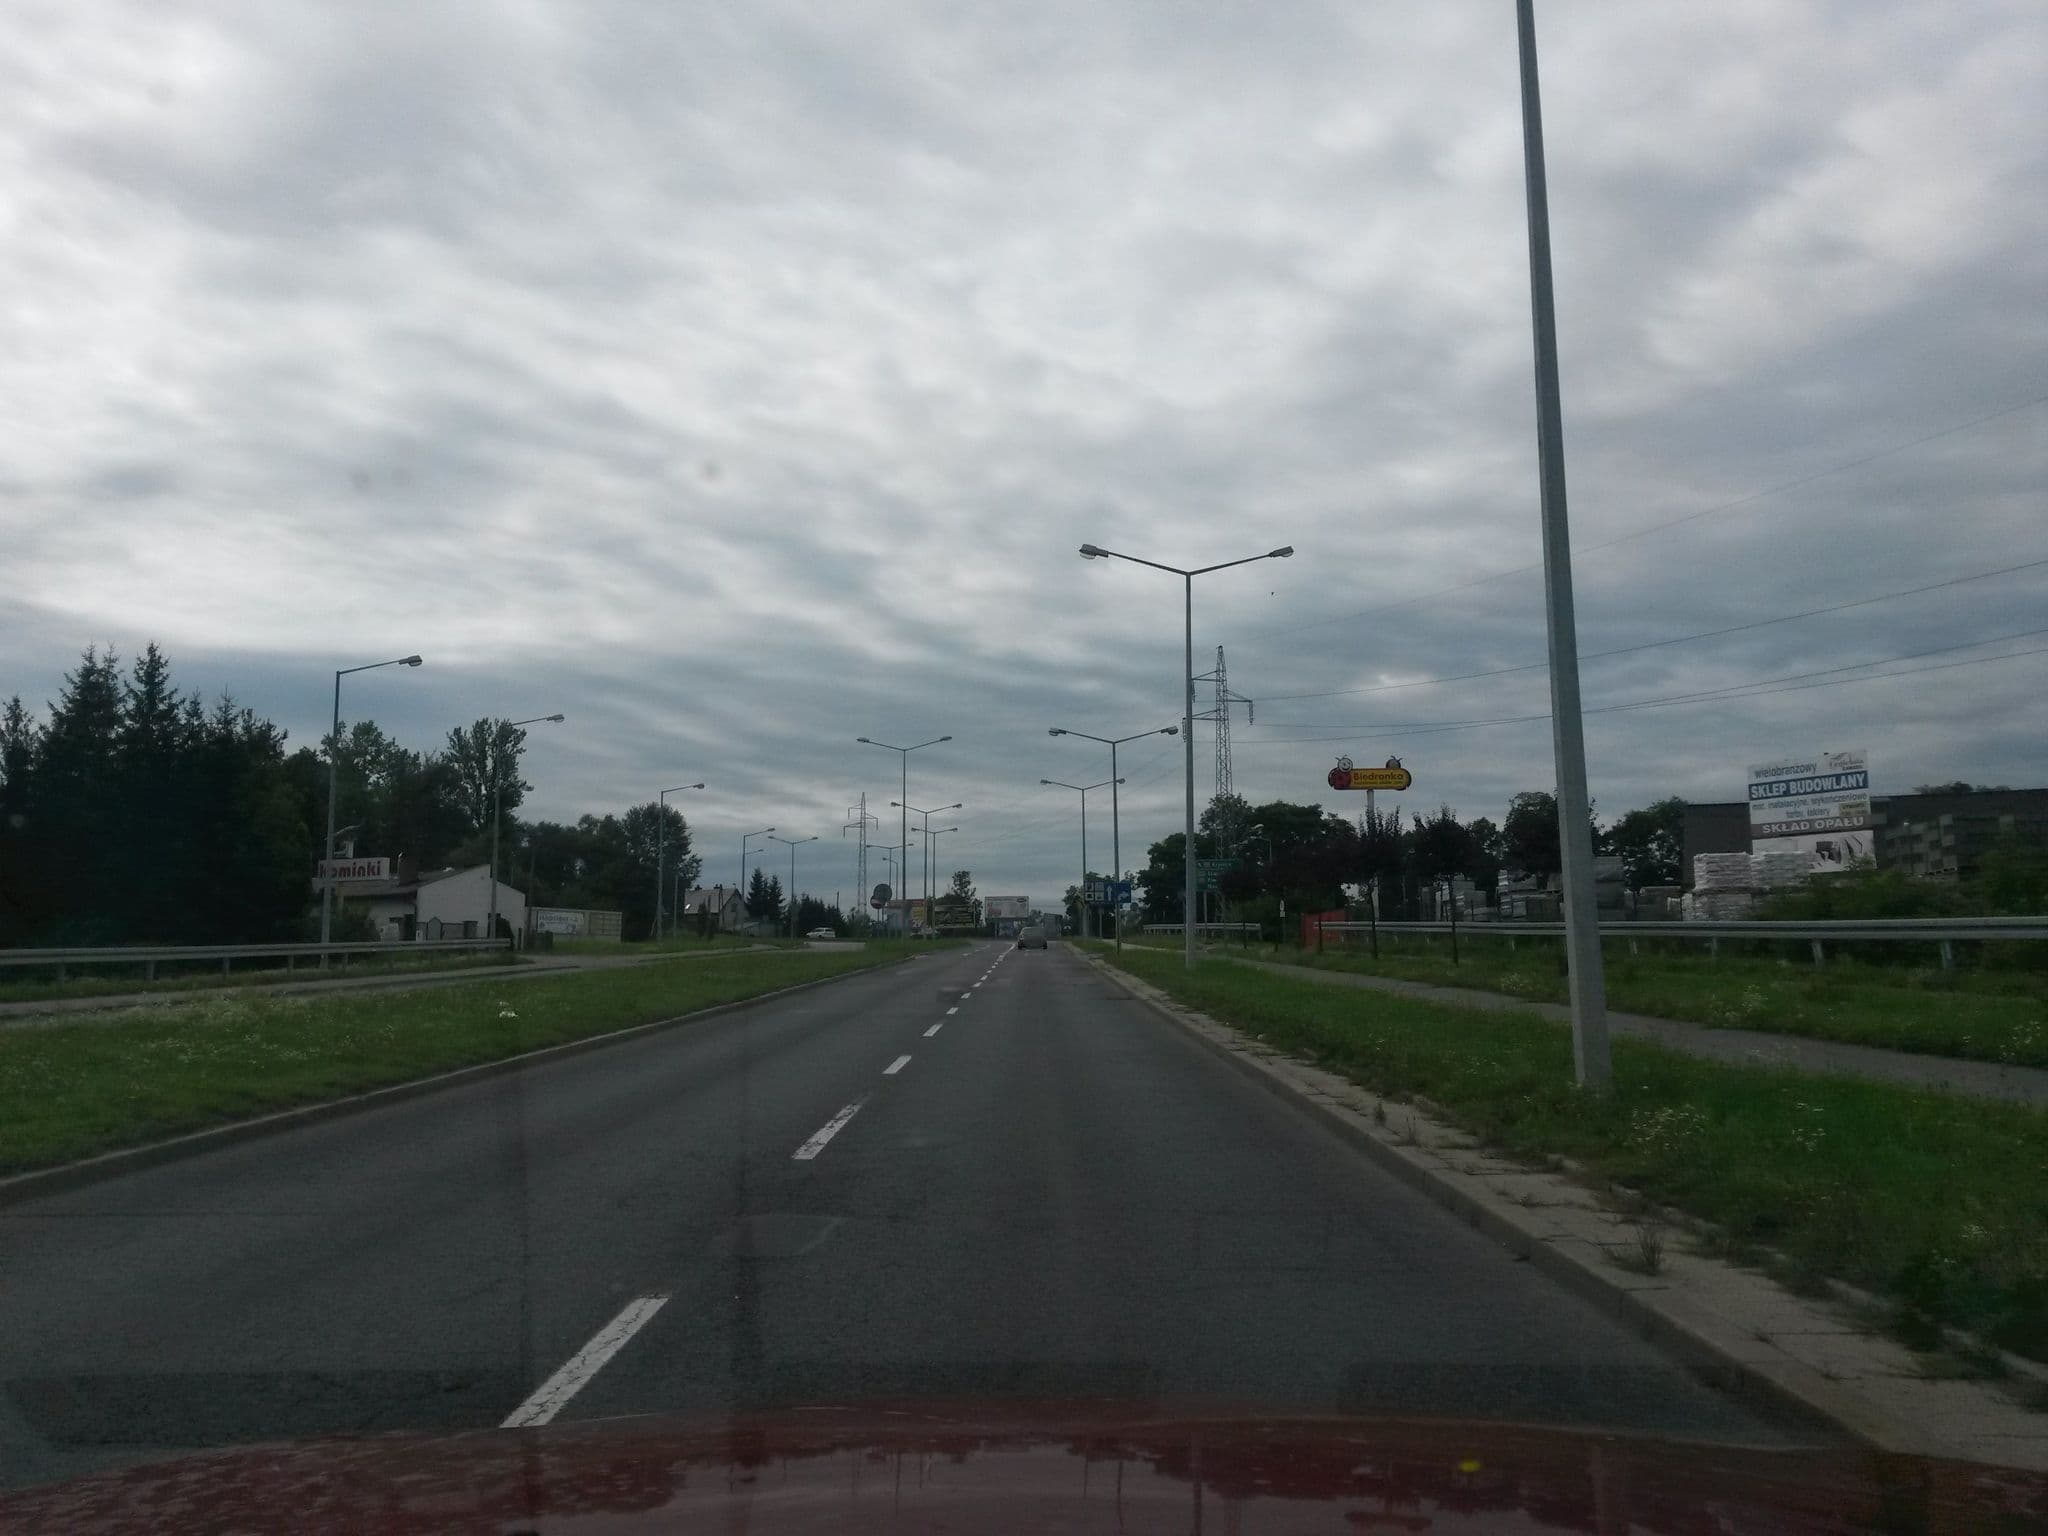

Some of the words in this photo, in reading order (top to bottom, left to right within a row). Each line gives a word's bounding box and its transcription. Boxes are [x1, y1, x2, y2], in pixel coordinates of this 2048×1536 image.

[1354, 773, 1403, 781] Biedronka
[1751, 785, 1787, 799] SKLEP
[1789, 774, 1864, 794] BUDOWLANY
[1763, 821, 1810, 833] SKŁAD
[1815, 816, 1864, 829] OPAŁU
